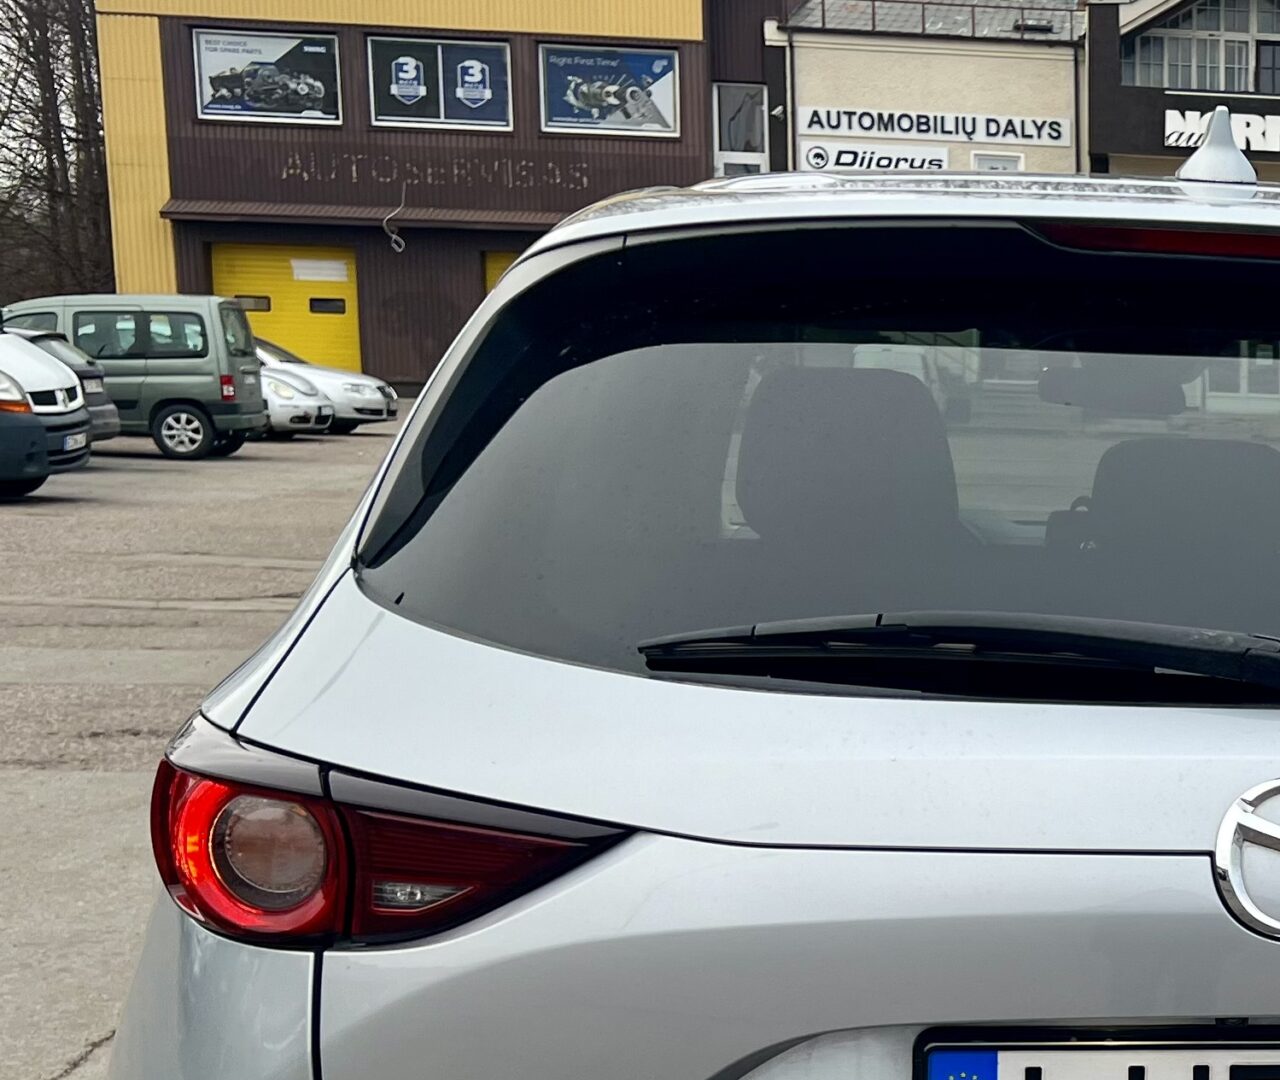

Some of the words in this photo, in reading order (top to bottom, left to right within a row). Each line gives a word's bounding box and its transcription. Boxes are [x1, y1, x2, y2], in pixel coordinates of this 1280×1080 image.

[398, 56, 418, 80] 3
[463, 59, 483, 83] 3
[807, 109, 977, 141] AUTOMOBILIŲ
[984, 118, 1063, 141] DALYS
[833, 150, 944, 169] Dijorus
